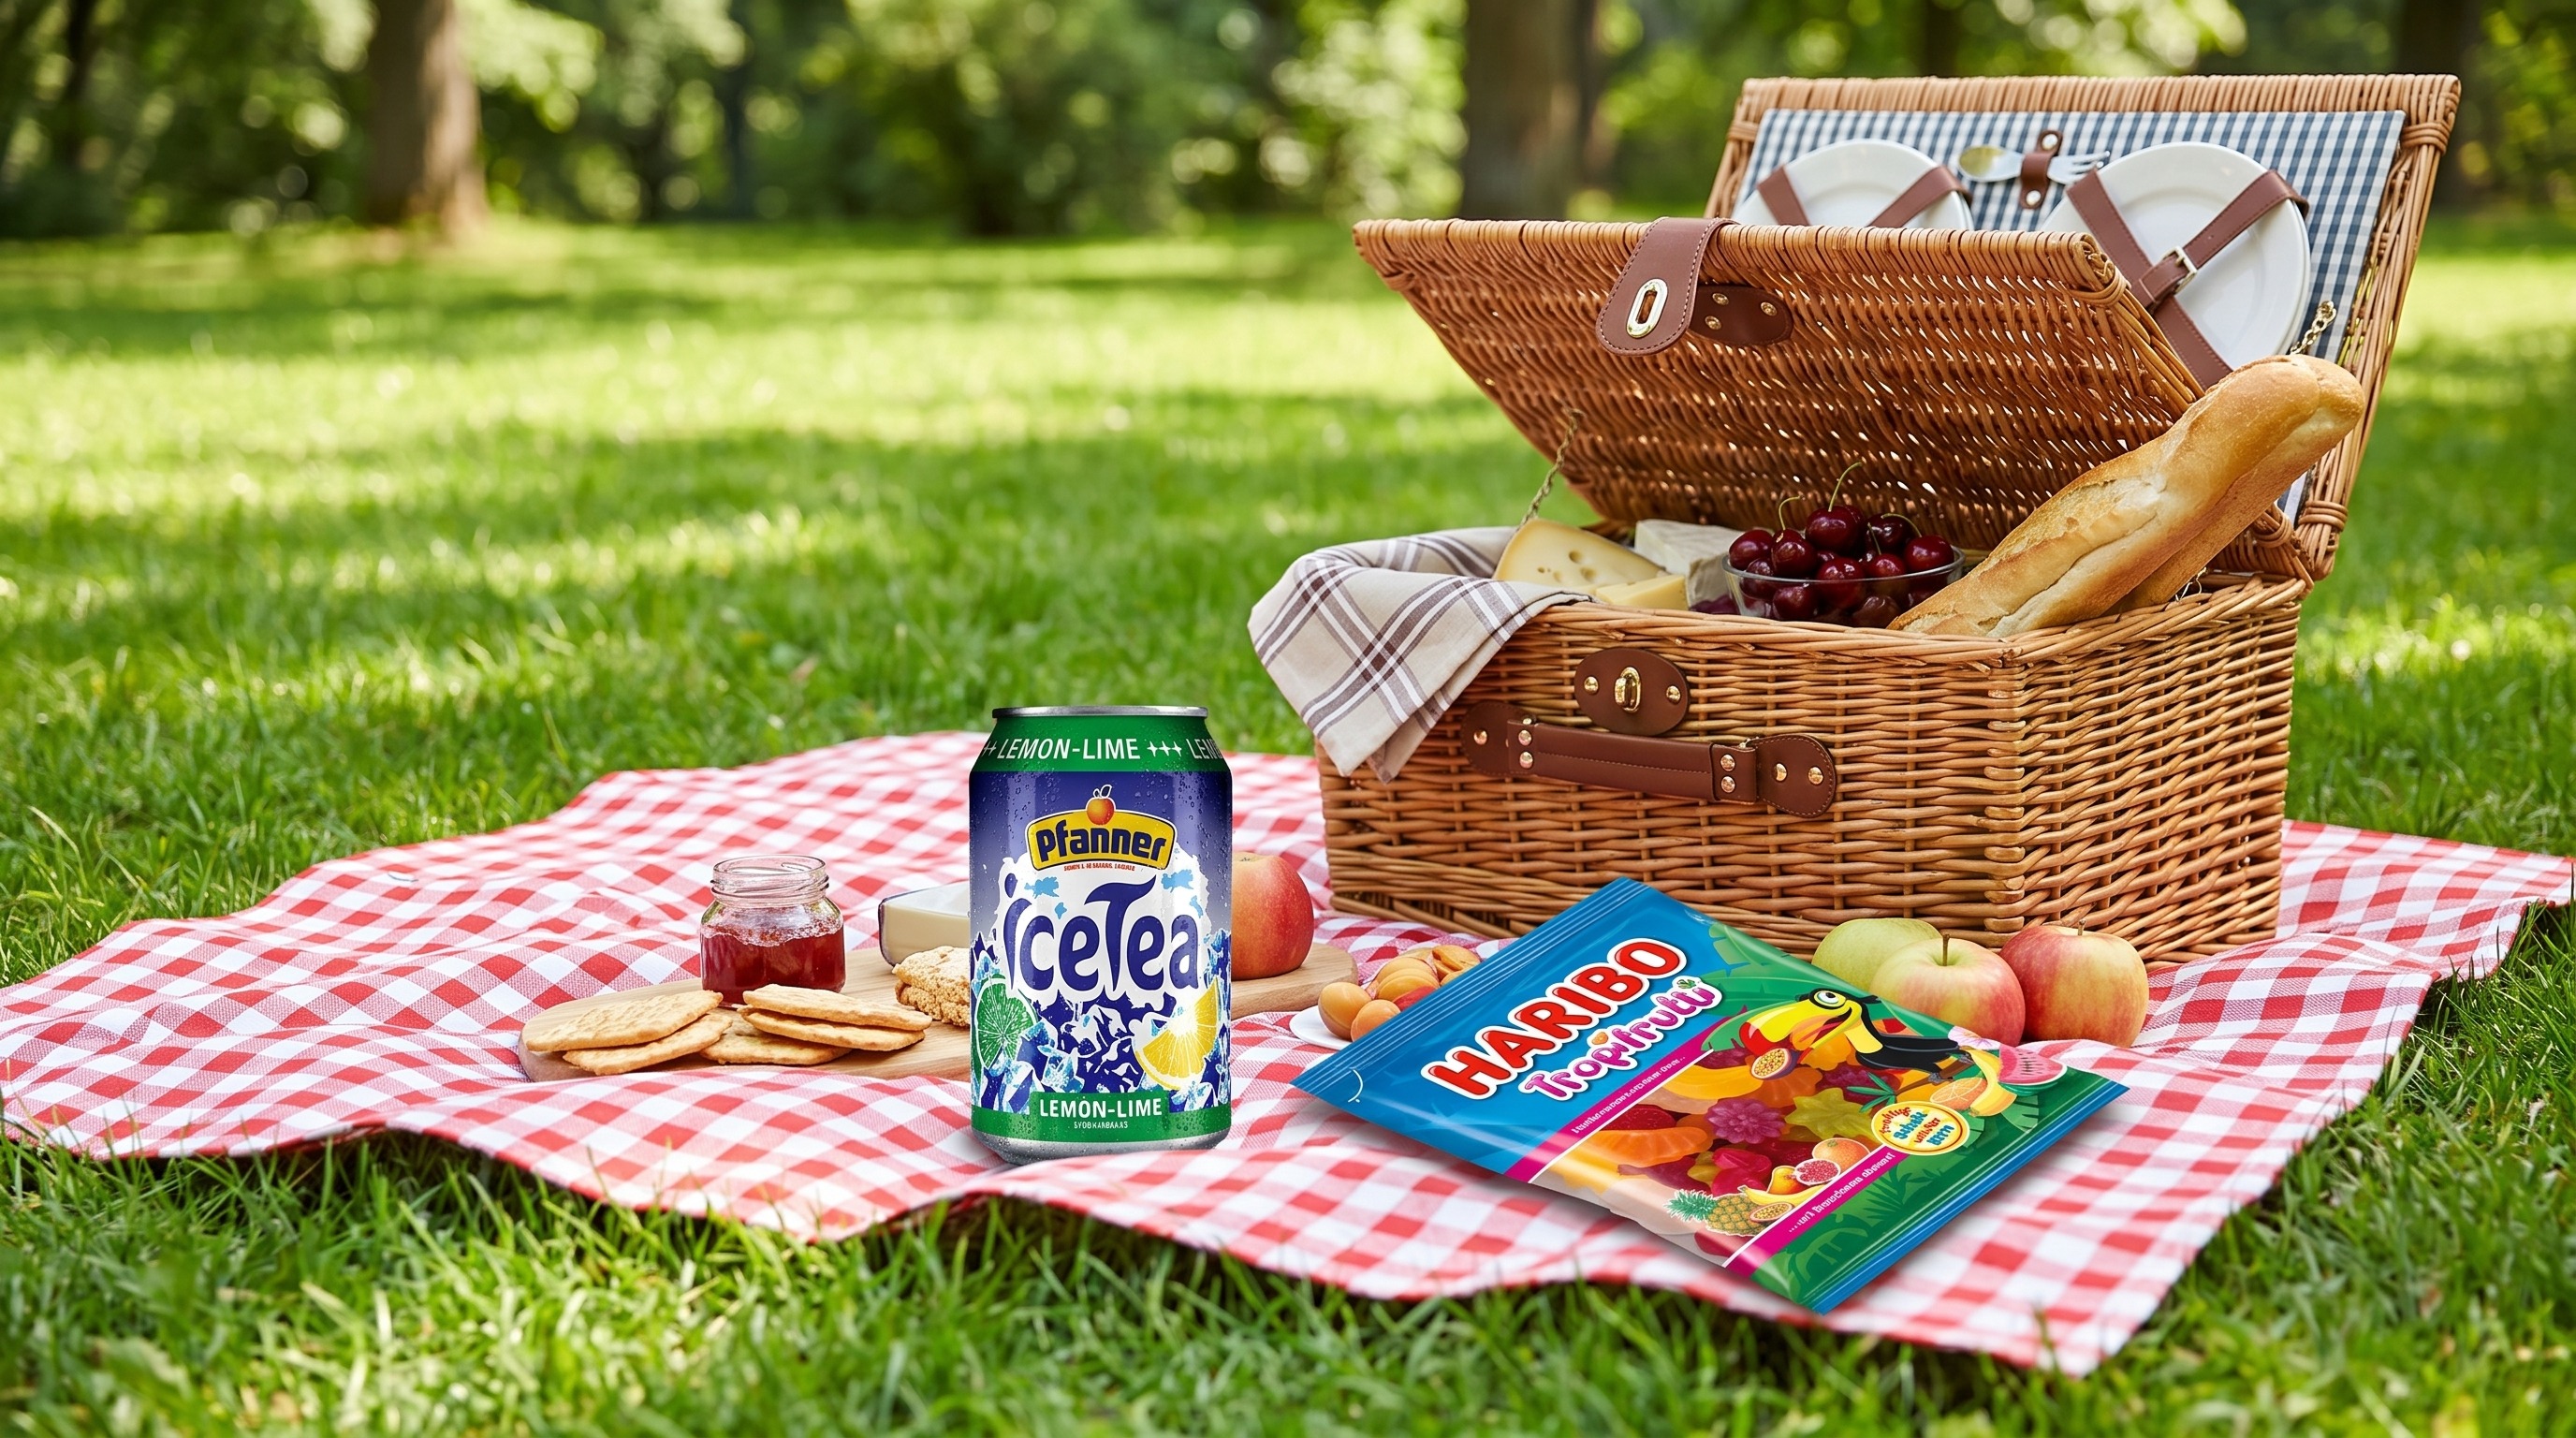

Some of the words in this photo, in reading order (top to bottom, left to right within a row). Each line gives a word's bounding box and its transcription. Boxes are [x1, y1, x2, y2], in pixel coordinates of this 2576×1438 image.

[997, 739, 1141, 759] LEMON-LIME
[1035, 819, 1167, 863] Pfanner
[1428, 941, 1681, 1096] HARIBO
[1039, 1096, 1163, 1119] LEMON-LIME
